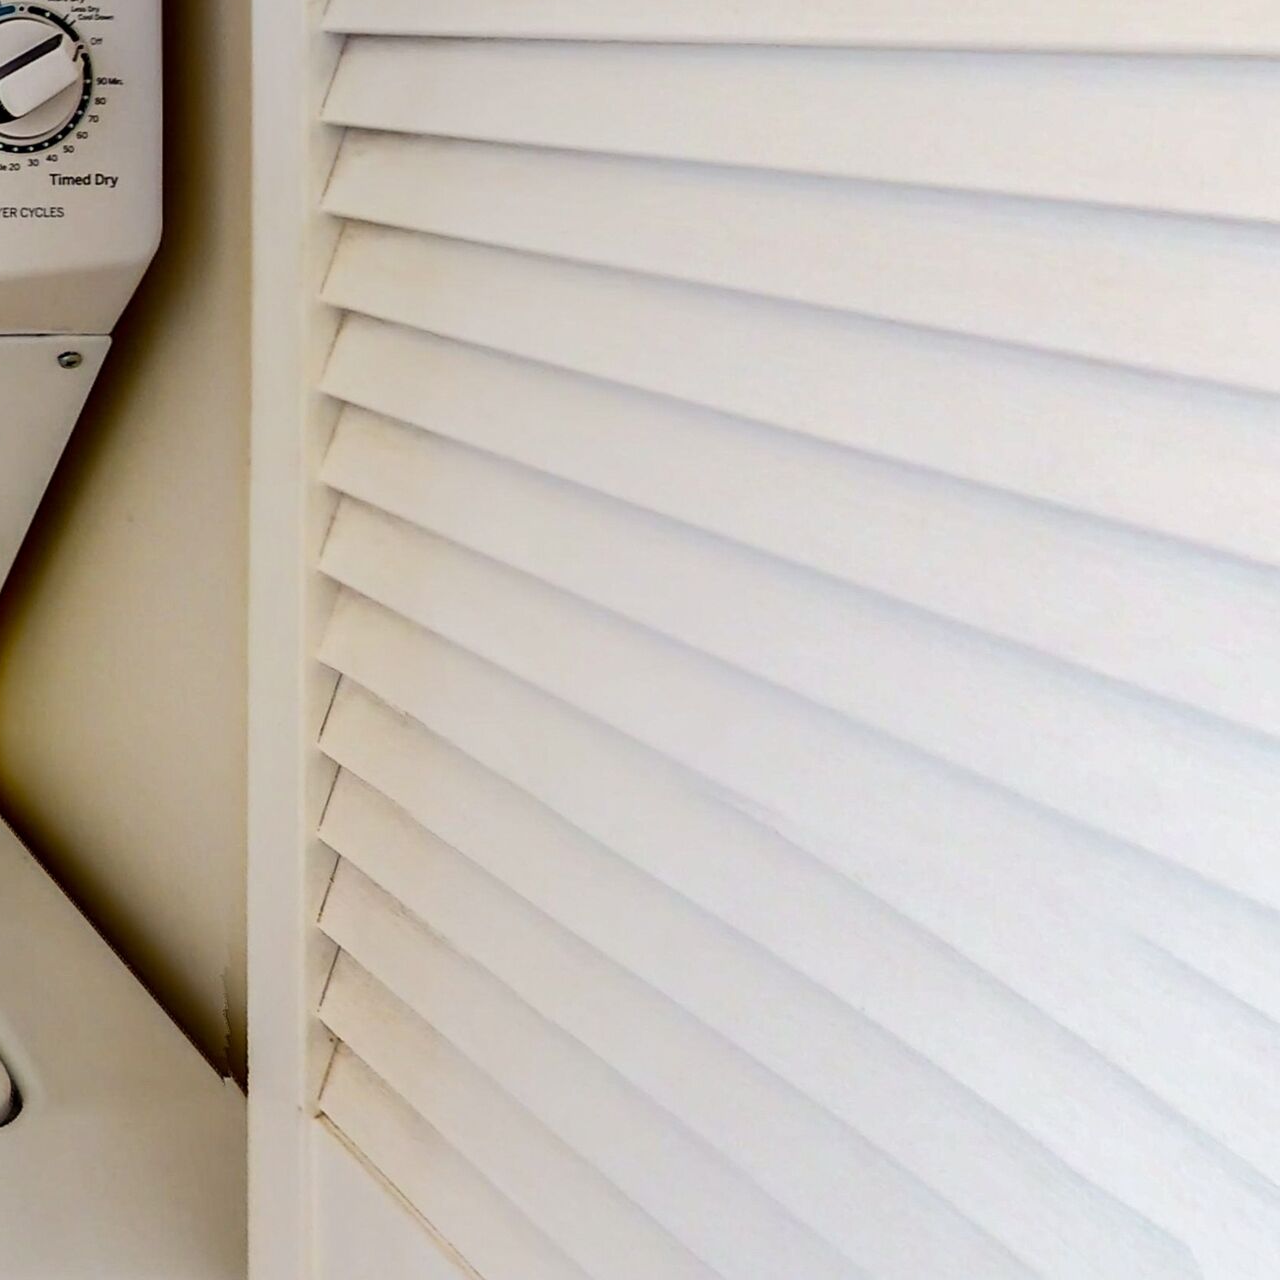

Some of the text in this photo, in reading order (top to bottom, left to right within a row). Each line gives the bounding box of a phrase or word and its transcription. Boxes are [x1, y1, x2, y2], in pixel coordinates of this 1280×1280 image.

[96, 77, 108, 85] 90
[95, 97, 106, 105] 80
[88, 115, 99, 123] 70
[76, 131, 88, 139] 60
[28, 159, 39, 167] 30
[49, 175, 118, 188] Timed Dry
[20, 208, 64, 218] CYCLES
